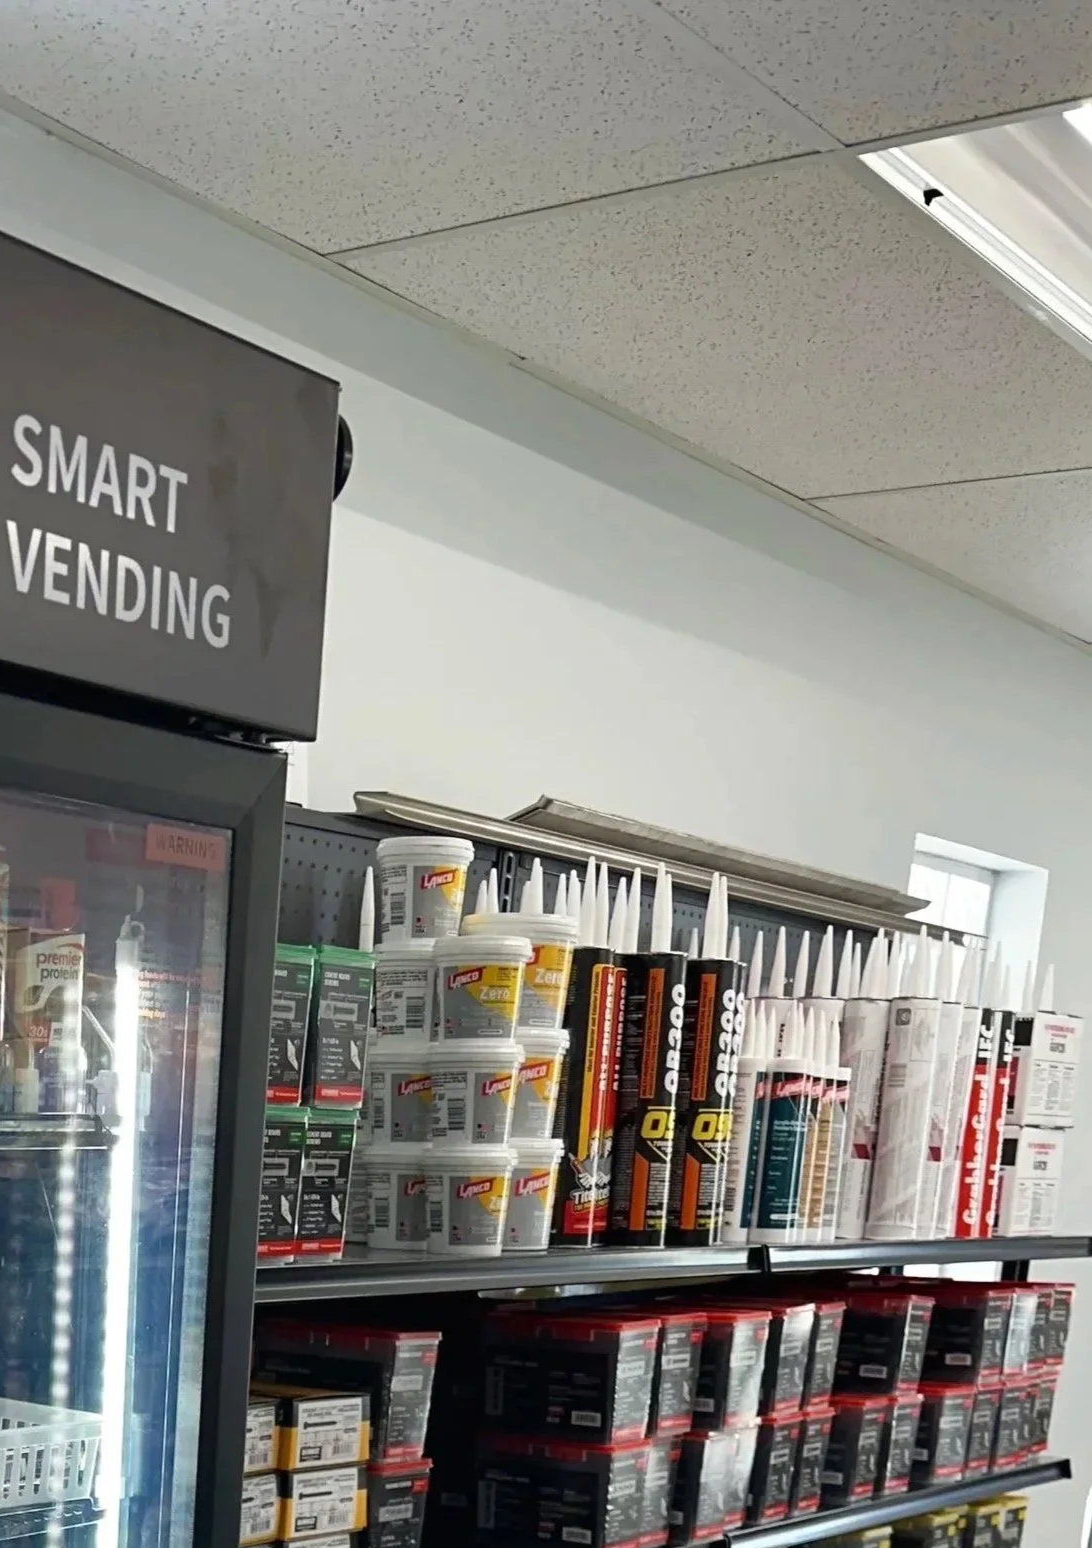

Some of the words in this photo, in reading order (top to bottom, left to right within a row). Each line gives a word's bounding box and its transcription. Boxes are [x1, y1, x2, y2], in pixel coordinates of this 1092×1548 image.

[11, 414, 188, 533] SMART
[7, 520, 230, 648] VENDING
[158, 832, 216, 860] WARNING
[36, 952, 82, 968] premier
[40, 968, 80, 982] protein
[479, 985, 510, 1000] Zero
